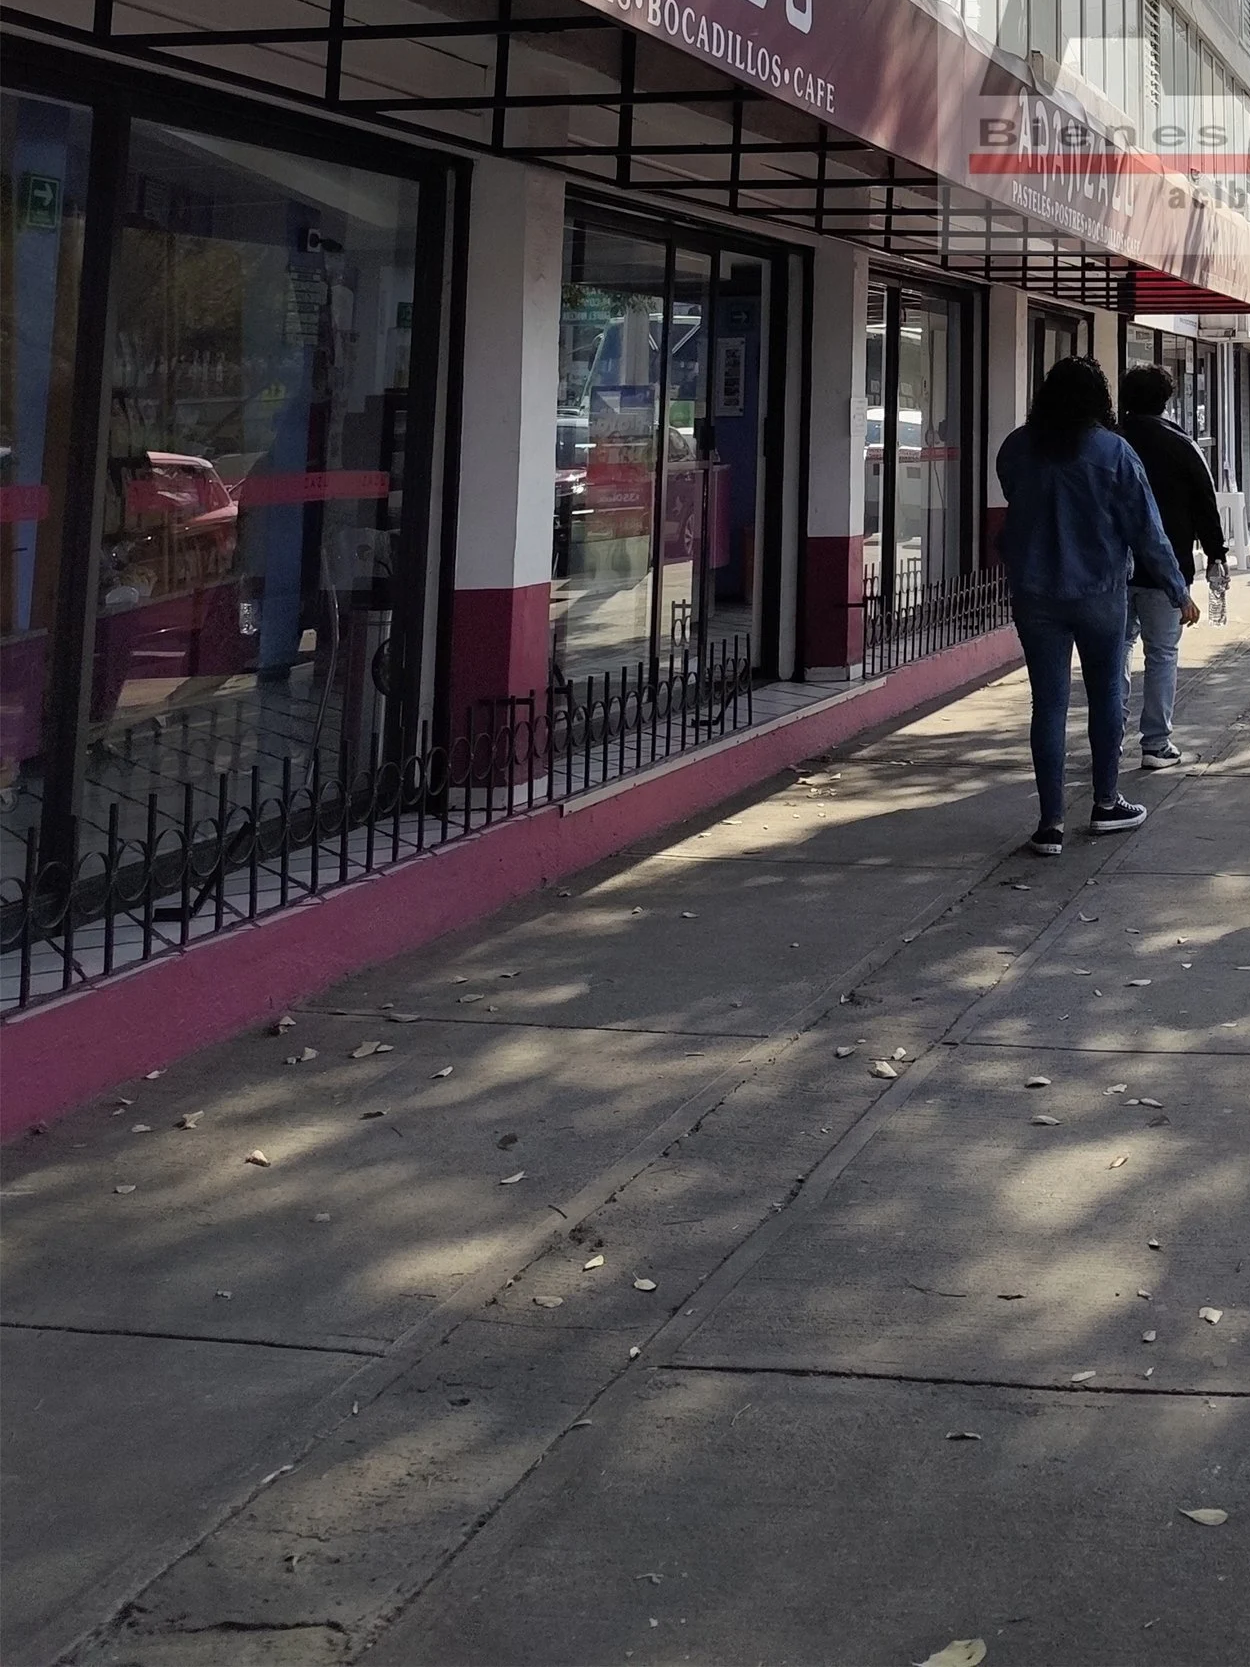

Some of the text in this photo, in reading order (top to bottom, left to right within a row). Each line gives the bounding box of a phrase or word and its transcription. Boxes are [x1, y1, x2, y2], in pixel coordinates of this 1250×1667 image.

[794, 66, 835, 114] CAFE
[1018, 86, 1136, 217] ARANZAZU
[1012, 180, 1051, 219] PASTELES
[1054, 201, 1085, 233] POSTRES
